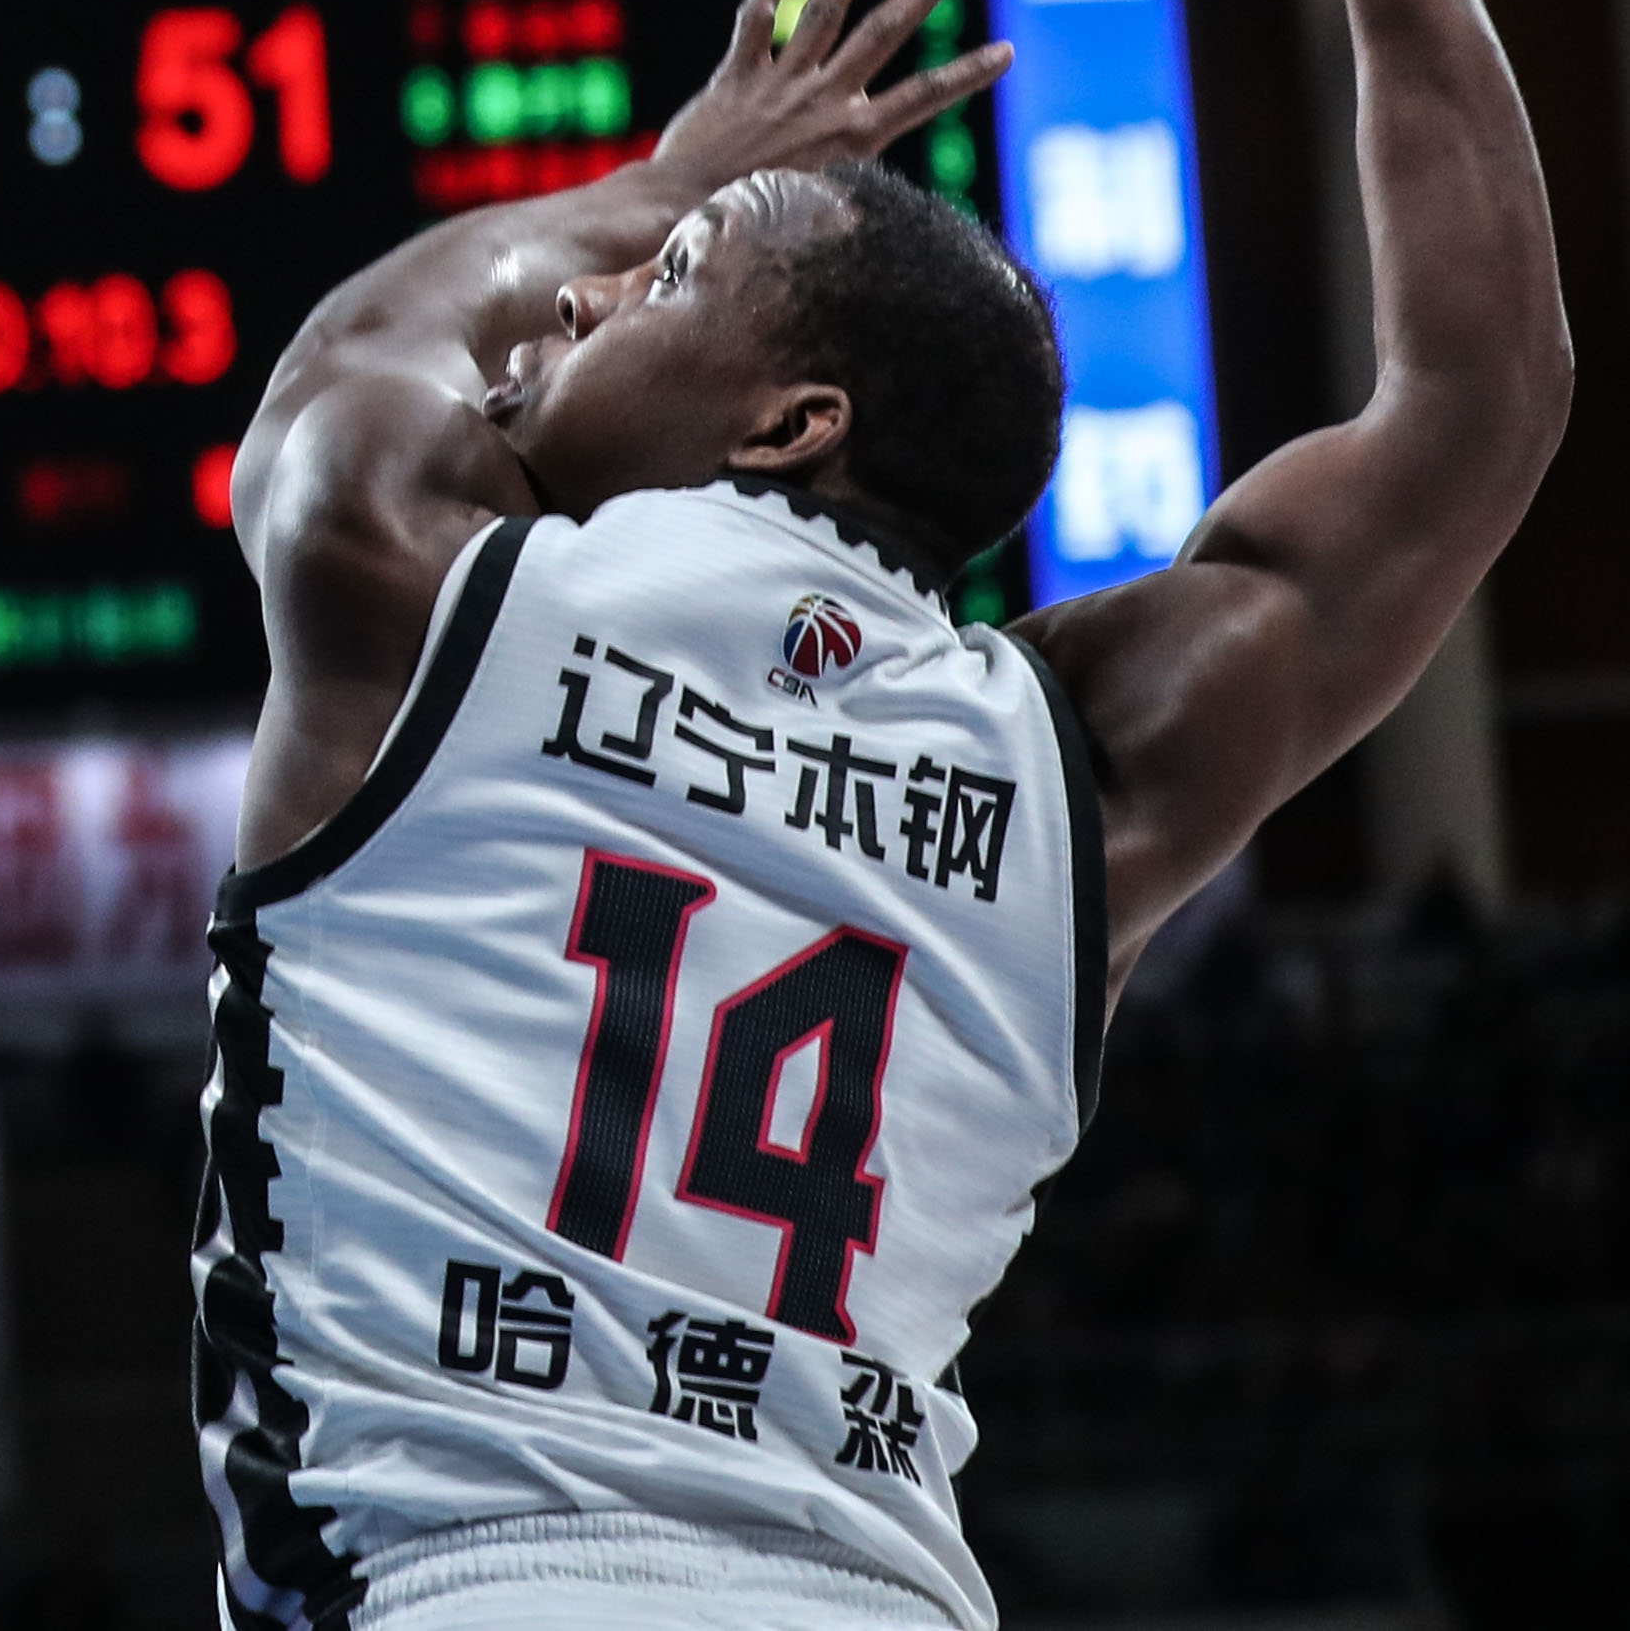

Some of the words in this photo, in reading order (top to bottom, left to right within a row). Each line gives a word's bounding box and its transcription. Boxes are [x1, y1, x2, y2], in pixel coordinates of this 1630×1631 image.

[136, 2, 333, 193] 51
[544, 636, 1017, 903] 辽宁本钢
[550, 846, 909, 1346] 14
